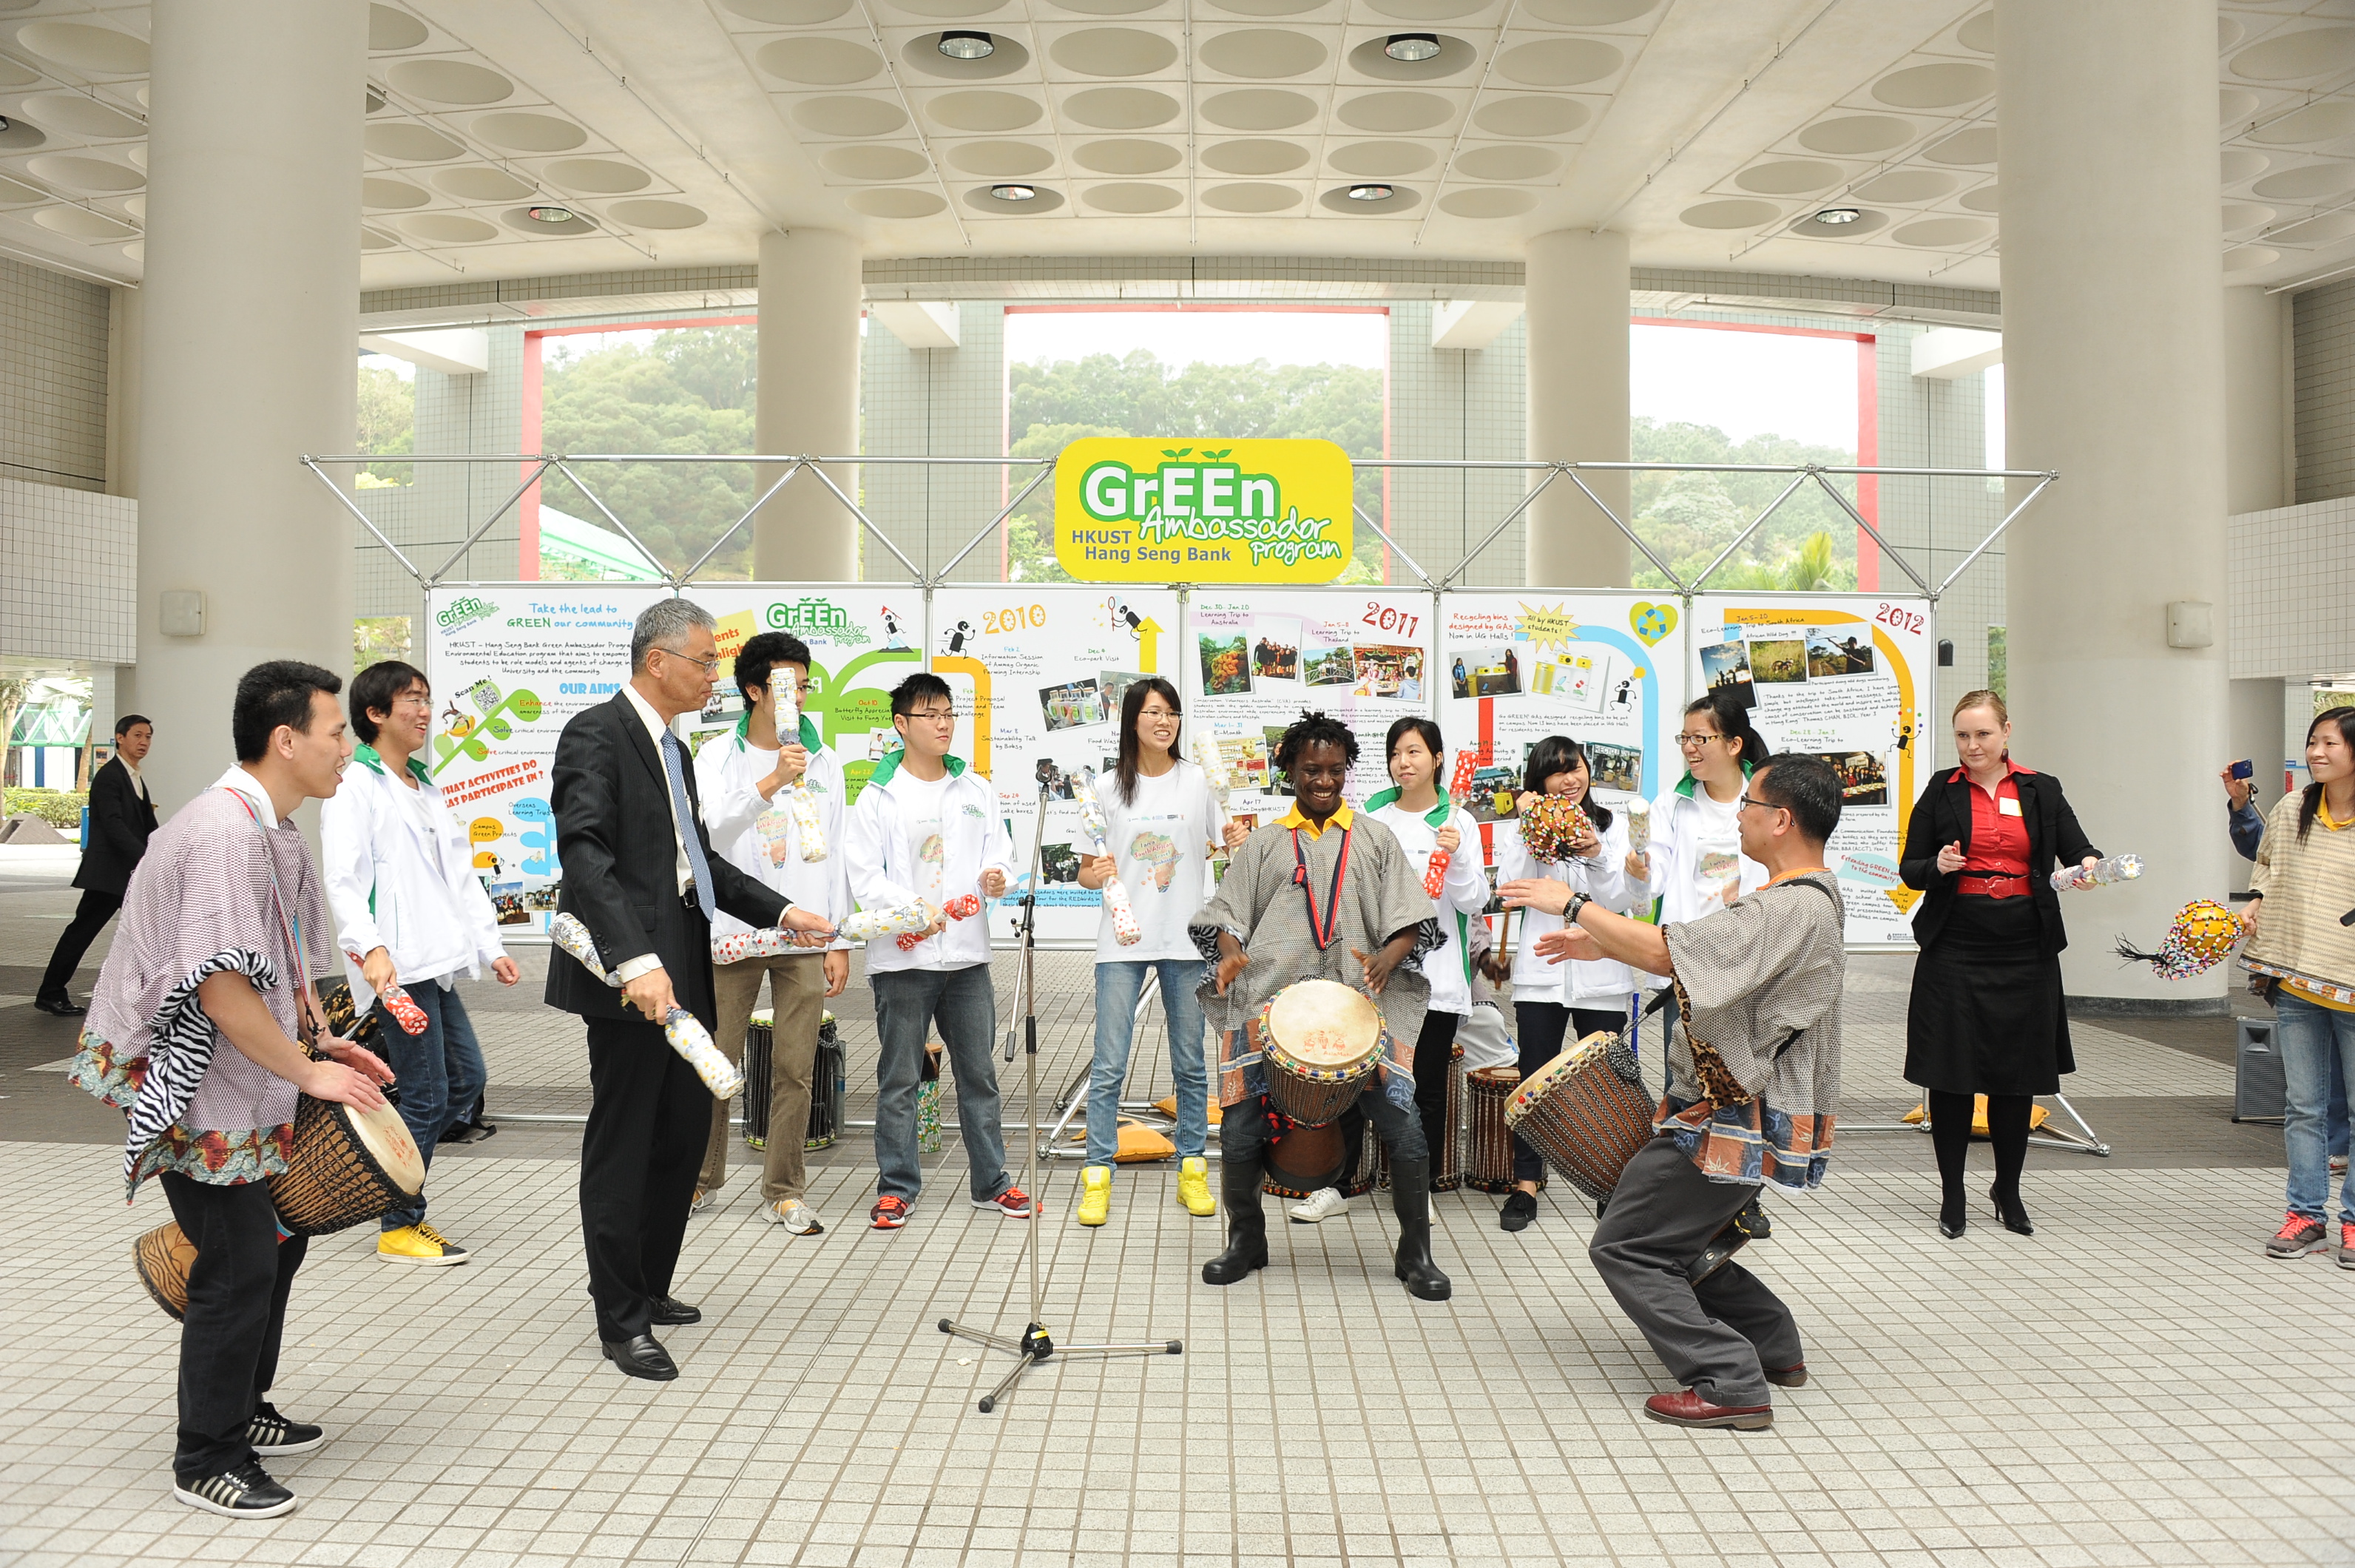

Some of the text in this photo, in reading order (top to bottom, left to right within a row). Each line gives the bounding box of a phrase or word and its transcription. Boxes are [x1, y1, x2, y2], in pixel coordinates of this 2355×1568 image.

[1081, 463, 1280, 520] GrEEn
[1140, 506, 1331, 544] Ambassador
[1072, 530, 1132, 544] HKUST
[1085, 546, 1231, 564] Hang Seng Bank
[1250, 540, 1342, 566] program
[529, 603, 617, 614] Take the lead to
[767, 604, 846, 629] GrEEn
[507, 617, 551, 628] GREEN
[575, 619, 633, 629] community
[983, 604, 1046, 635] 2010
[1362, 601, 1419, 638] 2011
[1453, 613, 1491, 622] Recycling
[1875, 603, 1925, 635] 2012
[790, 621, 867, 638] Ambassador
[1449, 623, 1483, 631] designed
[1484, 623, 1493, 631] by
[1701, 625, 1743, 634] Eco-Learning
[485, 641, 502, 649] Hang
[504, 641, 522, 649] Seng
[608, 641, 631, 649] Progra
[834, 635, 871, 646] program
[599, 659, 622, 667] change
[455, 678, 487, 698] Scan Me
[559, 683, 621, 695] OUR AIMS
[477, 747, 497, 755] Solve
[468, 764, 521, 788] ACTIVITIES
[521, 760, 537, 771] DO
[460, 772, 538, 803] PARTICIPATE IN
[1134, 842, 1173, 857] South African
[1841, 855, 1890, 873] Extending GREEN
[1868, 871, 1896, 883] community
